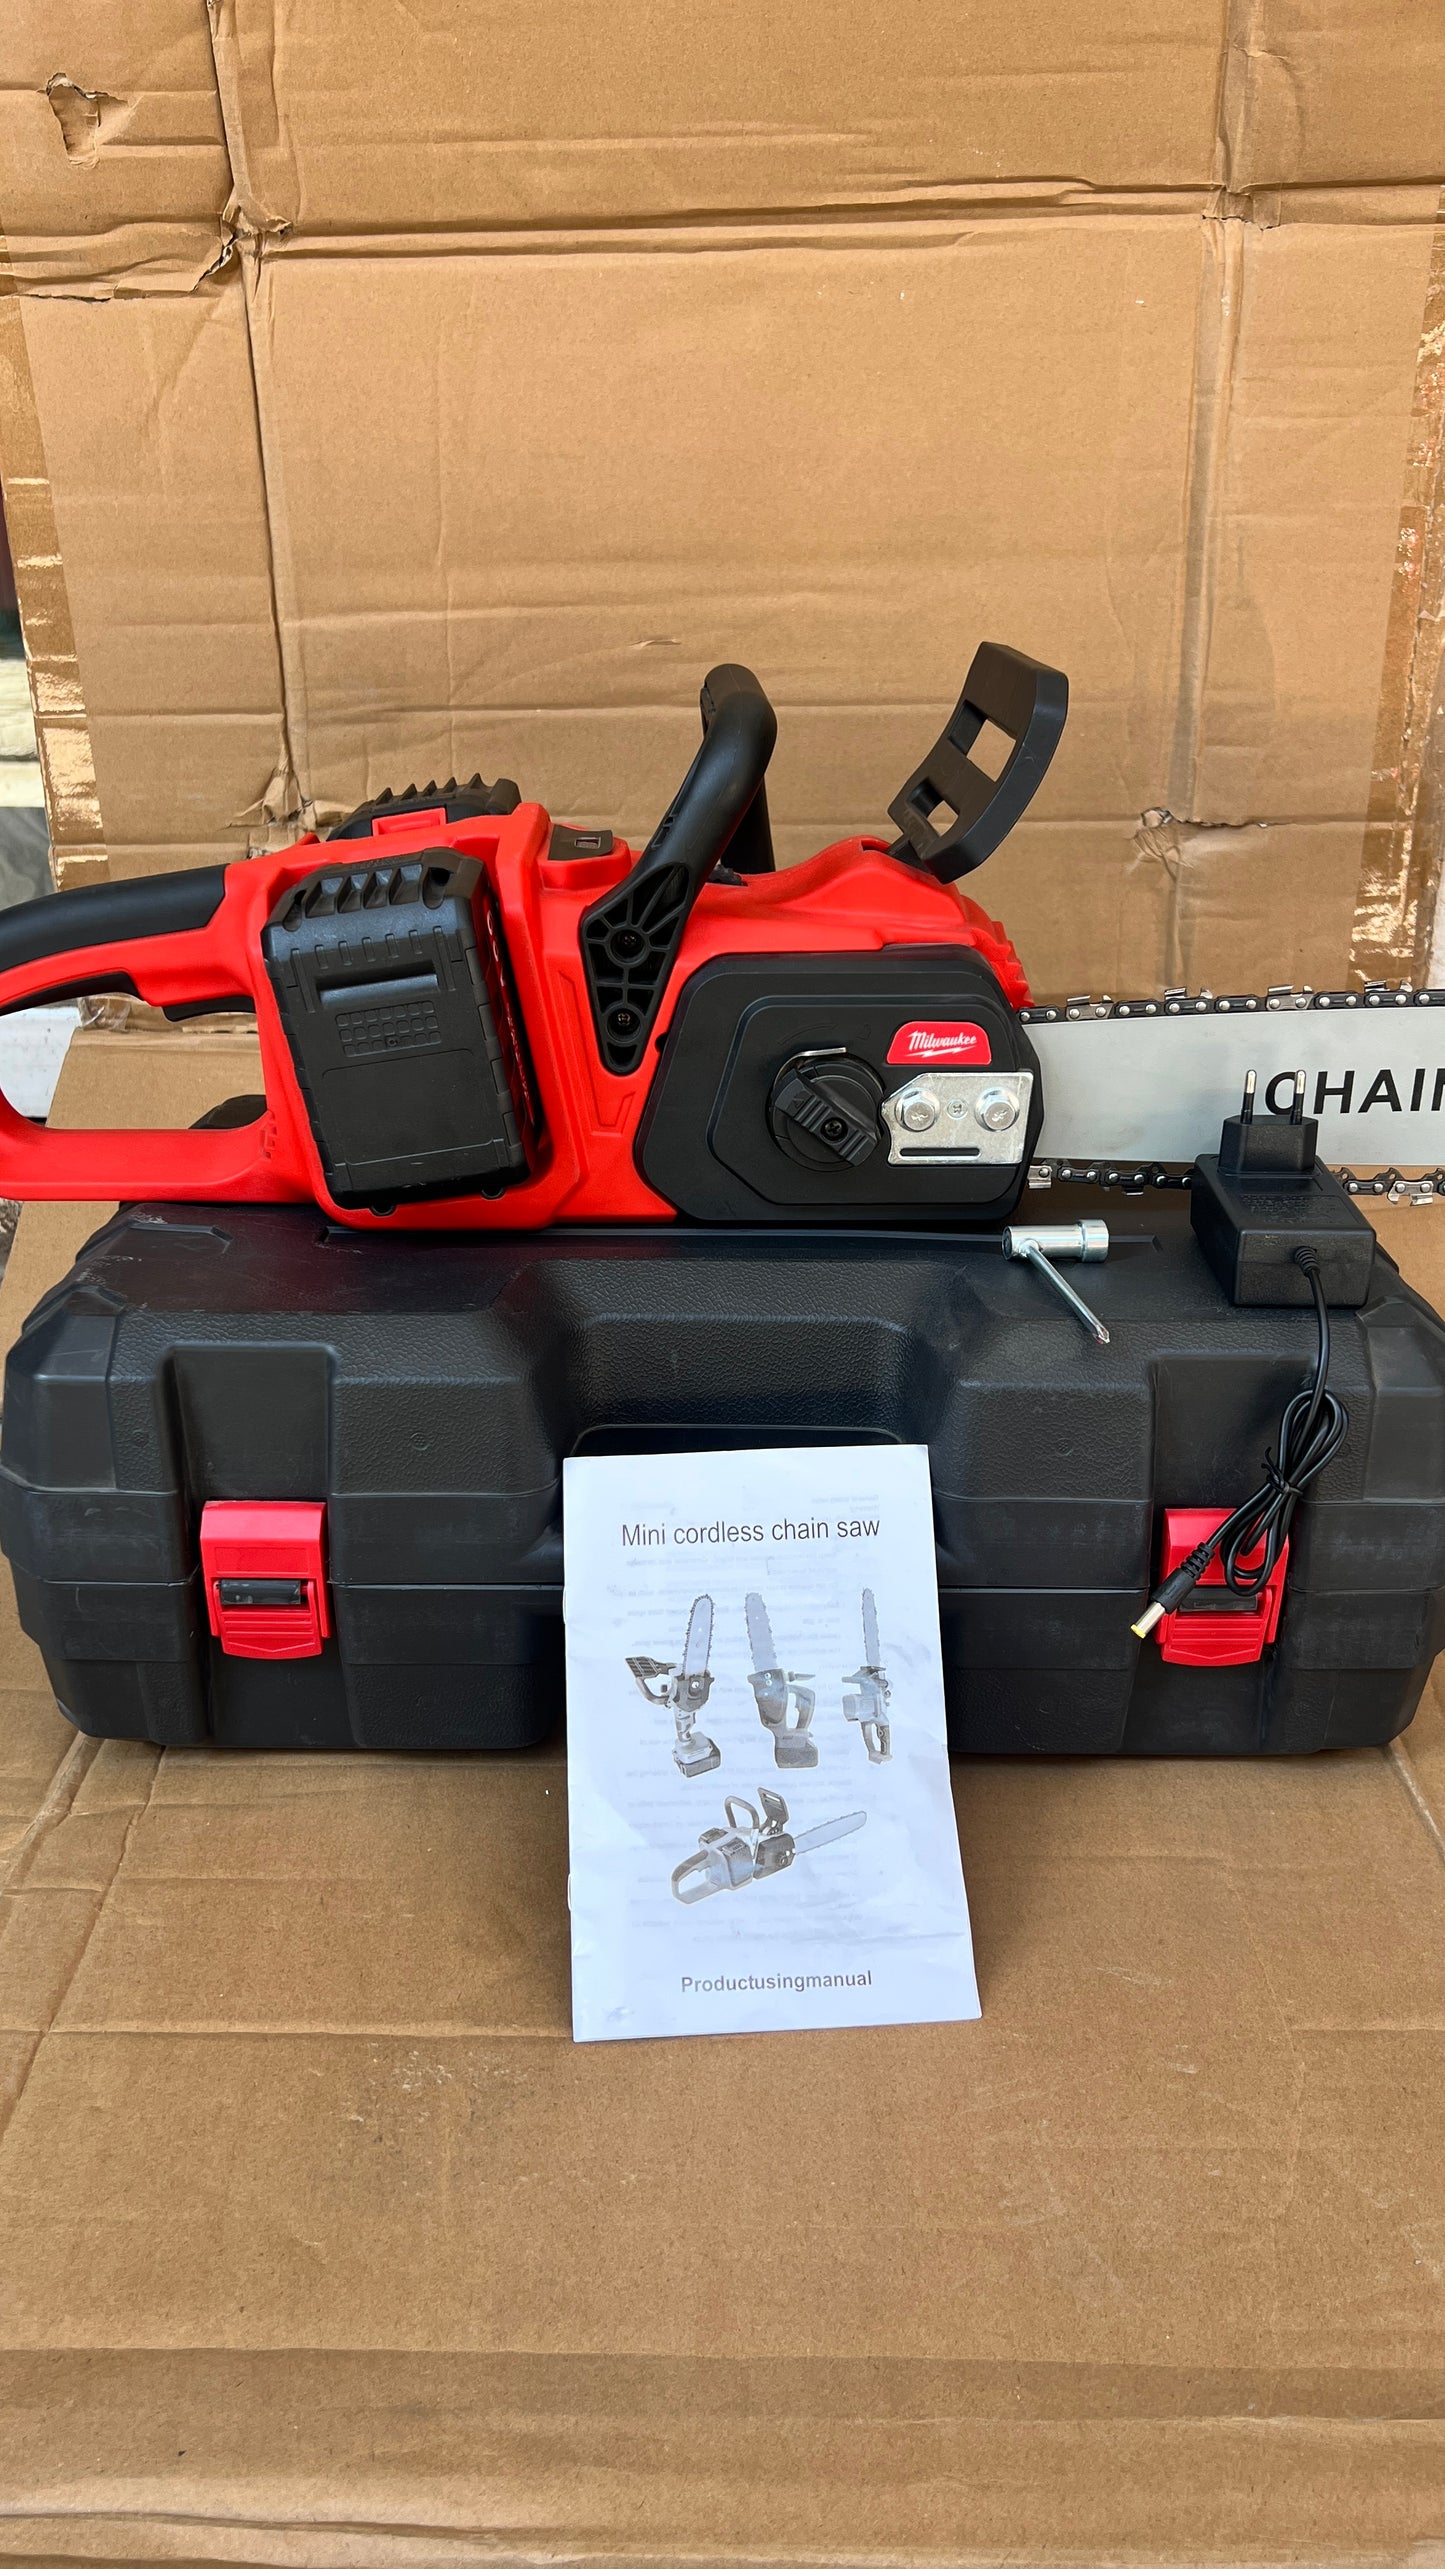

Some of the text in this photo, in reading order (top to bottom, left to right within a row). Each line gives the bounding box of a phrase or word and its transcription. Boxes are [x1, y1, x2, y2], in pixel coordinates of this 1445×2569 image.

[907, 1030, 977, 1050] Milwaukee
[622, 1517, 880, 1546] Mini cordless chain saw
[681, 1970, 872, 1992] Productusingmanual
